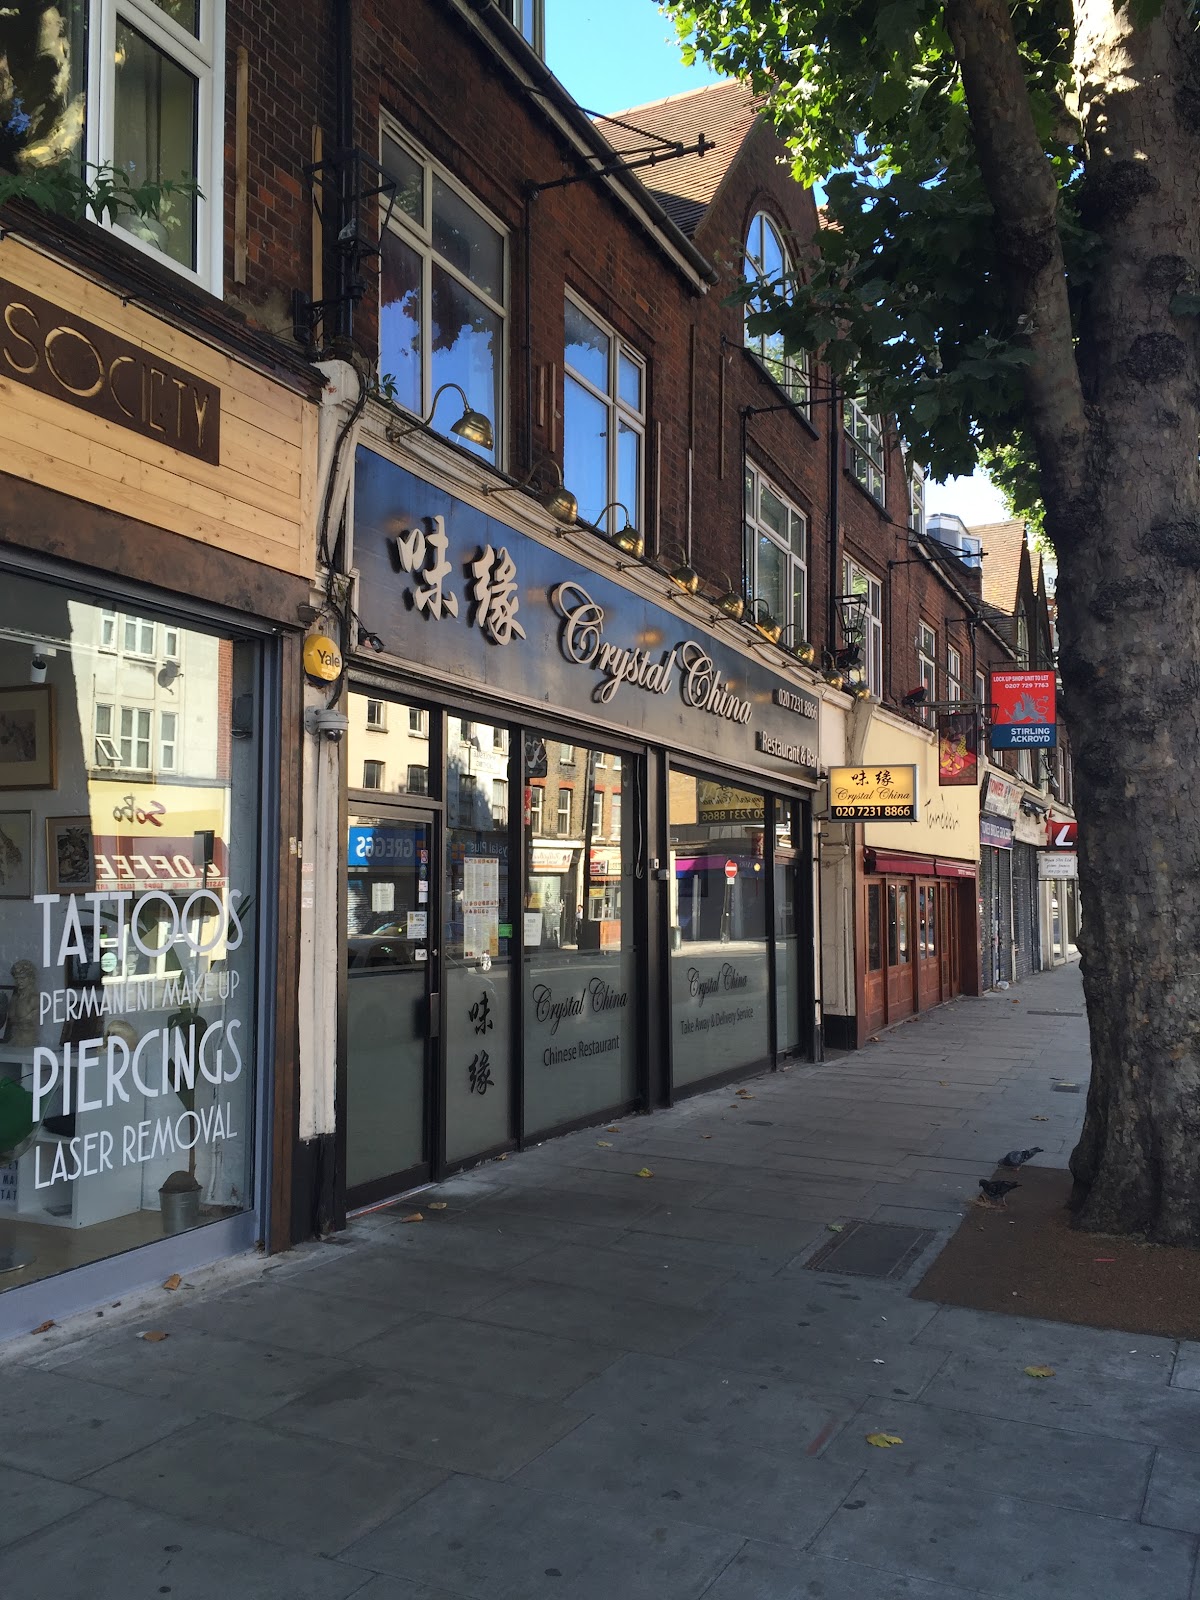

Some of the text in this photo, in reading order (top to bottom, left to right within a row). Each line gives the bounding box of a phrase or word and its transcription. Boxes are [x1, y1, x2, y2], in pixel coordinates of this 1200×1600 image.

[317, 649, 340, 667] Yale
[552, 581, 753, 724] Crystal China
[778, 688, 818, 720] 020 7231 8866
[1011, 727, 1050, 735] STIRLING
[1011, 735, 1050, 743] ACKROYD
[762, 730, 818, 768] Restaurant & Bar
[835, 787, 911, 804] Crystal China
[835, 806, 911, 817] 020 7231 8866
[33, 889, 244, 968] TATTOOS
[39, 970, 240, 1026] PERMANENT MAKE UP
[687, 962, 747, 1008] Crystal China
[532, 976, 628, 1035] Crystal China
[681, 1019, 694, 1034] Take
[695, 1017, 710, 1033] Away
[715, 1010, 736, 1026] Delivery
[737, 1006, 753, 1021] Service
[543, 1035, 620, 1067] Chinese Restaurant
[32, 1019, 243, 1123] PIERCINGS
[35, 1101, 238, 1189] LASER REMOVAL
